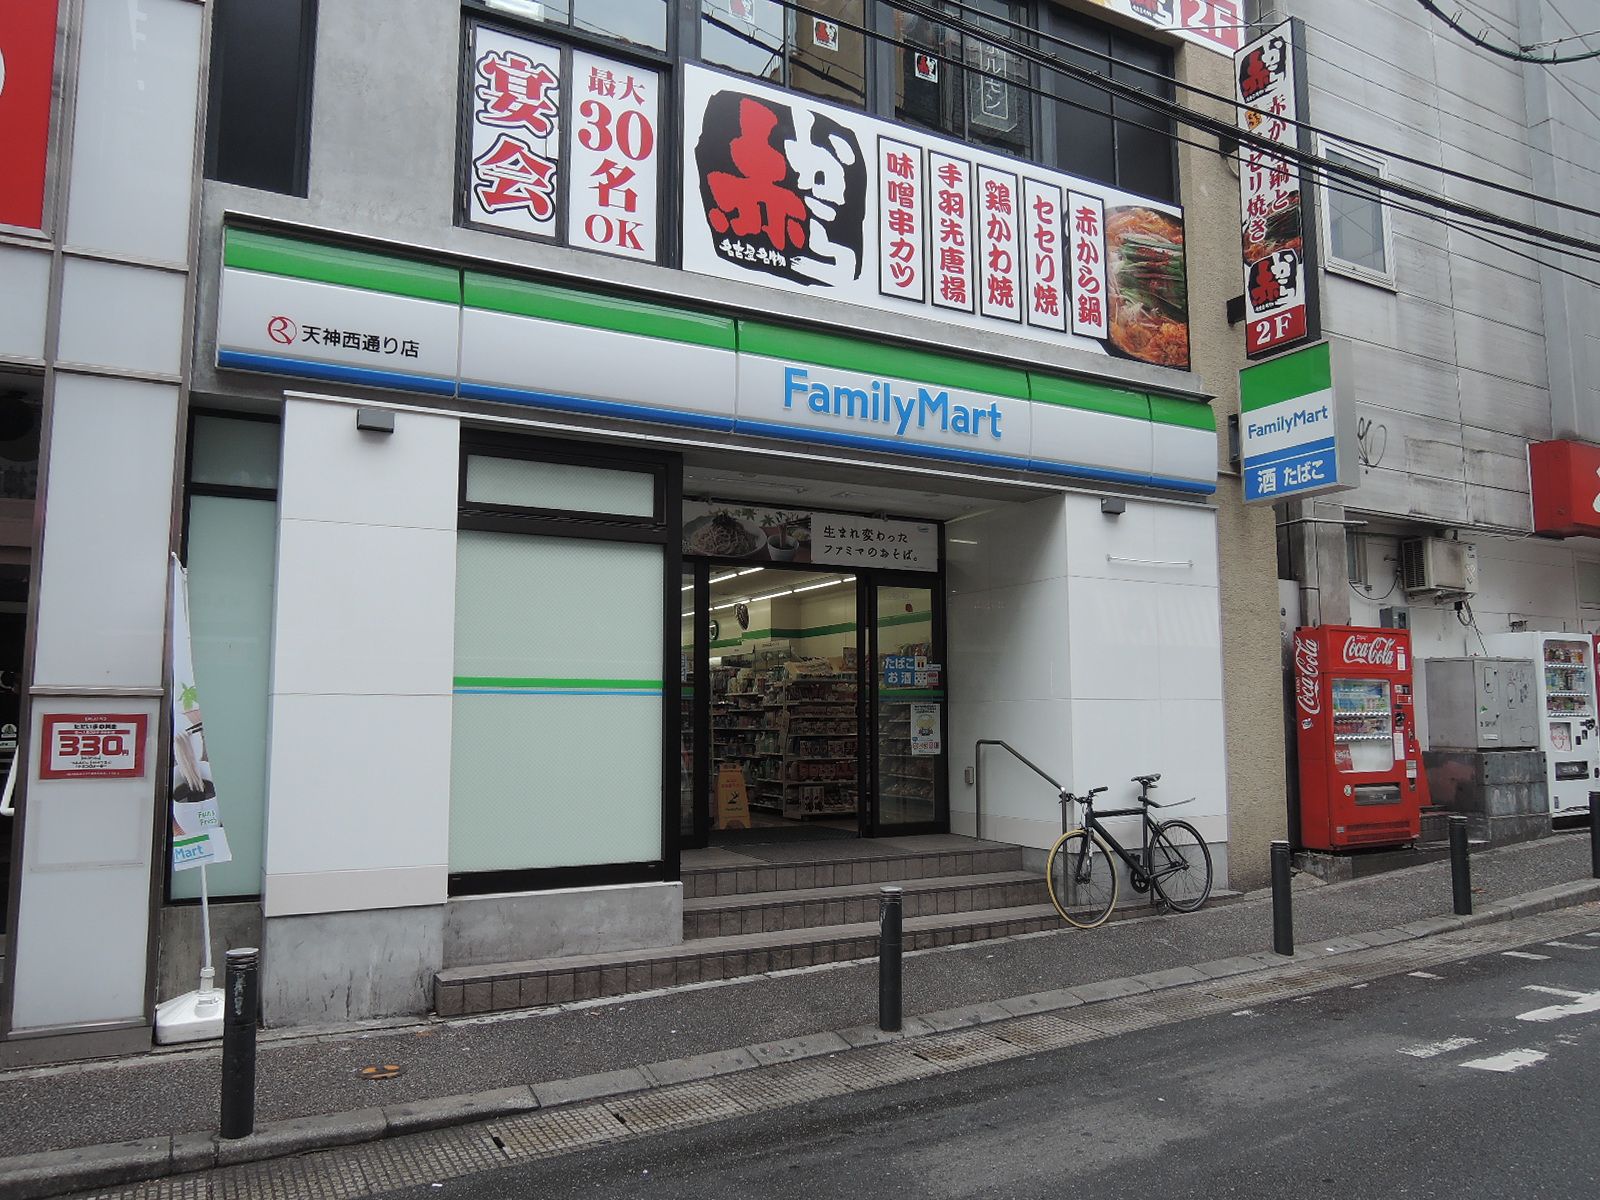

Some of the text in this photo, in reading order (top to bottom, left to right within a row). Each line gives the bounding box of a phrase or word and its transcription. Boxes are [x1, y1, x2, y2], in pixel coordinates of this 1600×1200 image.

[588, 66, 646, 104] 最大
[478, 53, 557, 220] 宴会
[577, 100, 654, 161] 30
[588, 158, 638, 213] 名
[584, 214, 645, 252] OK
[887, 152, 915, 288] 味噌串カツ
[937, 162, 966, 304] 手羽先唐揚
[985, 180, 1014, 308] 鶏かわ焼
[1075, 206, 1102, 327] 赤から鍋
[302, 325, 420, 358] 天神西通り店
[1256, 313, 1292, 345] 2F
[784, 366, 1002, 440] FamilyMart
[1248, 405, 1328, 439] FamilyMart
[1257, 459, 1325, 493] 酒 たばこ
[823, 525, 908, 543] 生まれ変わった
[885, 656, 915, 669] たばこ
[1343, 635, 1395, 665] Coca-Cola
